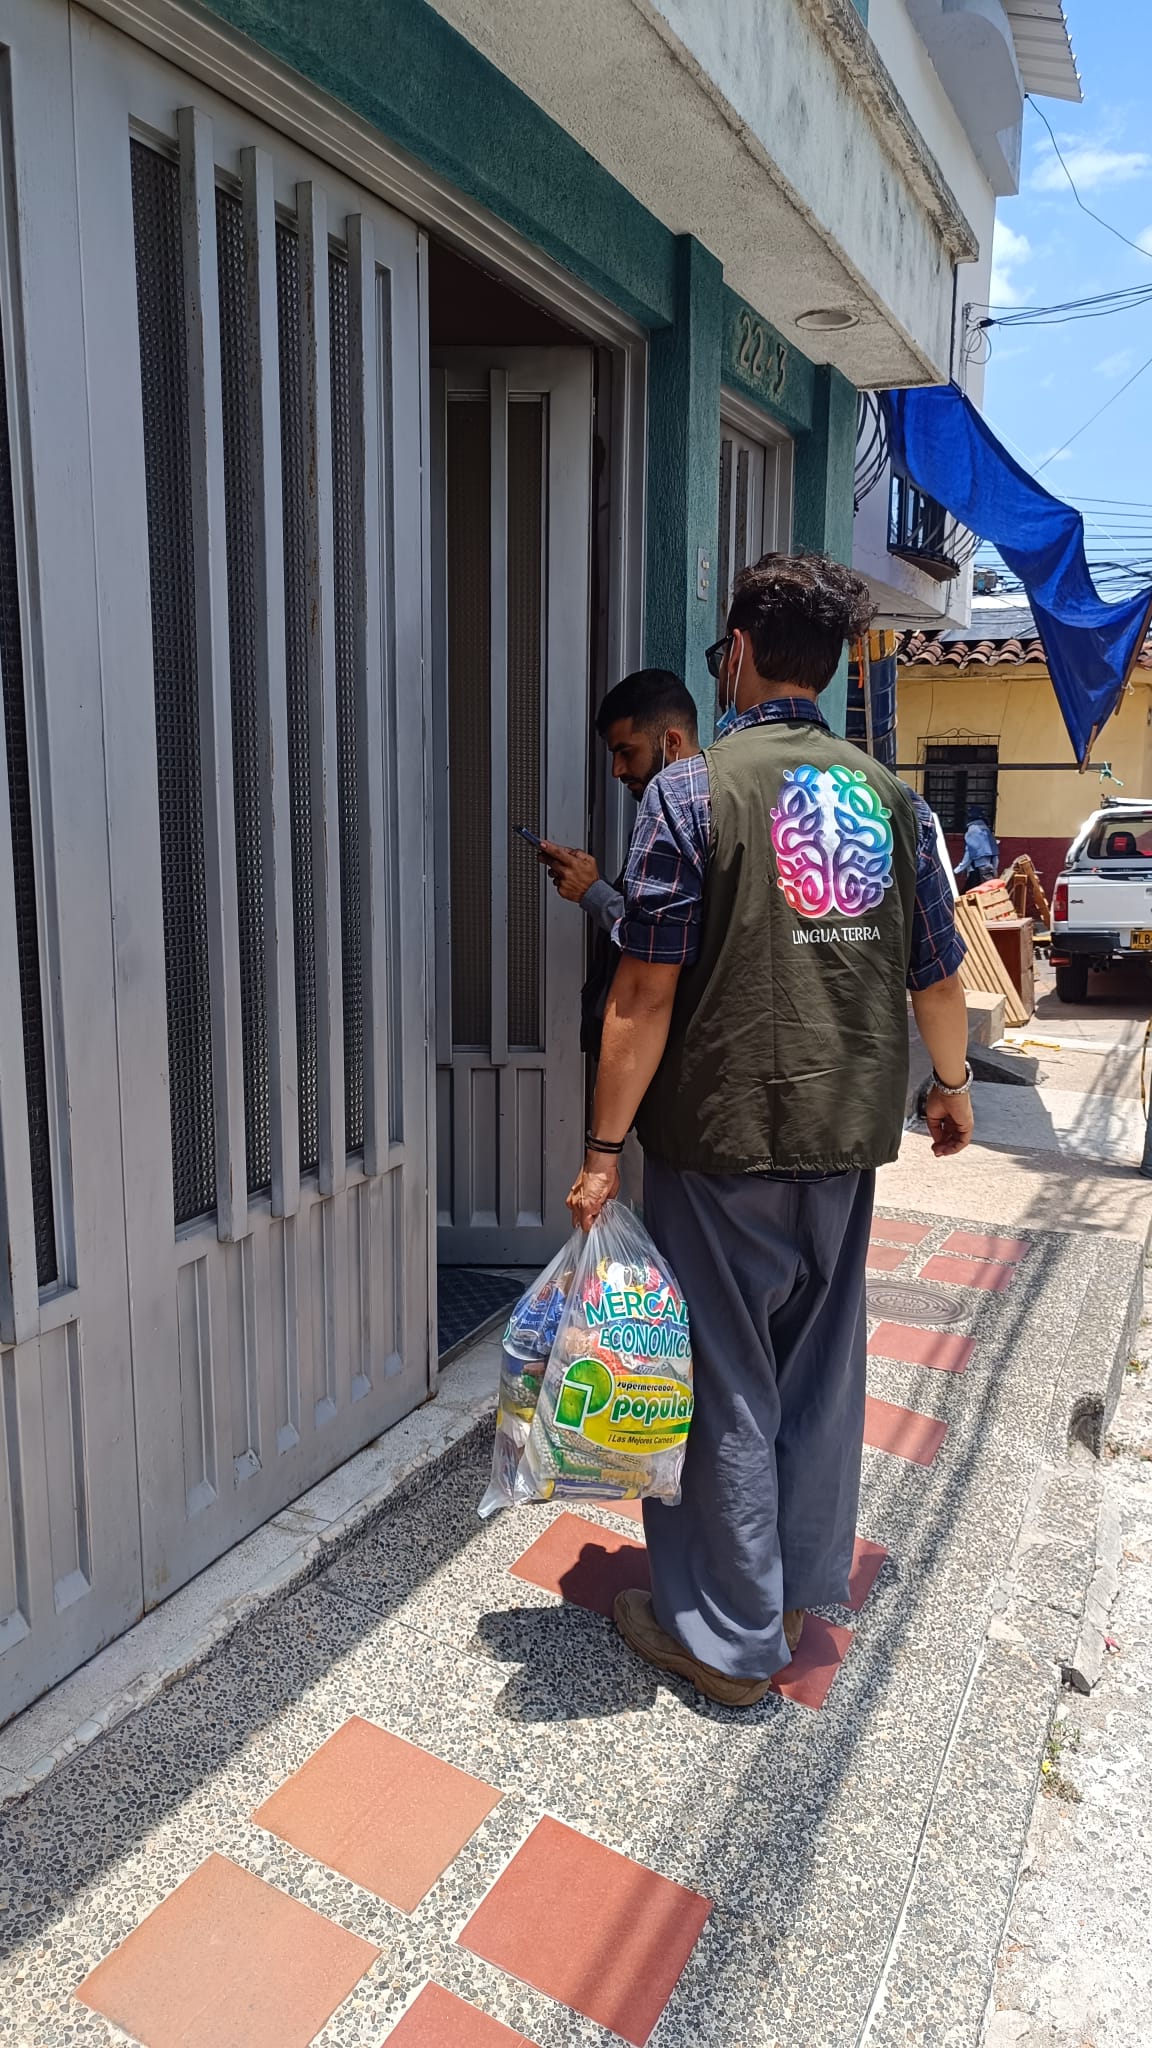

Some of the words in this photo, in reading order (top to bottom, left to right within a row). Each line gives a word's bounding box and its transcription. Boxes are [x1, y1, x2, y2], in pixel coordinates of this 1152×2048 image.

[791, 927, 840, 945] LINGUA
[841, 926, 881, 942] TERRA
[627, 1436, 653, 1446] Mejores
